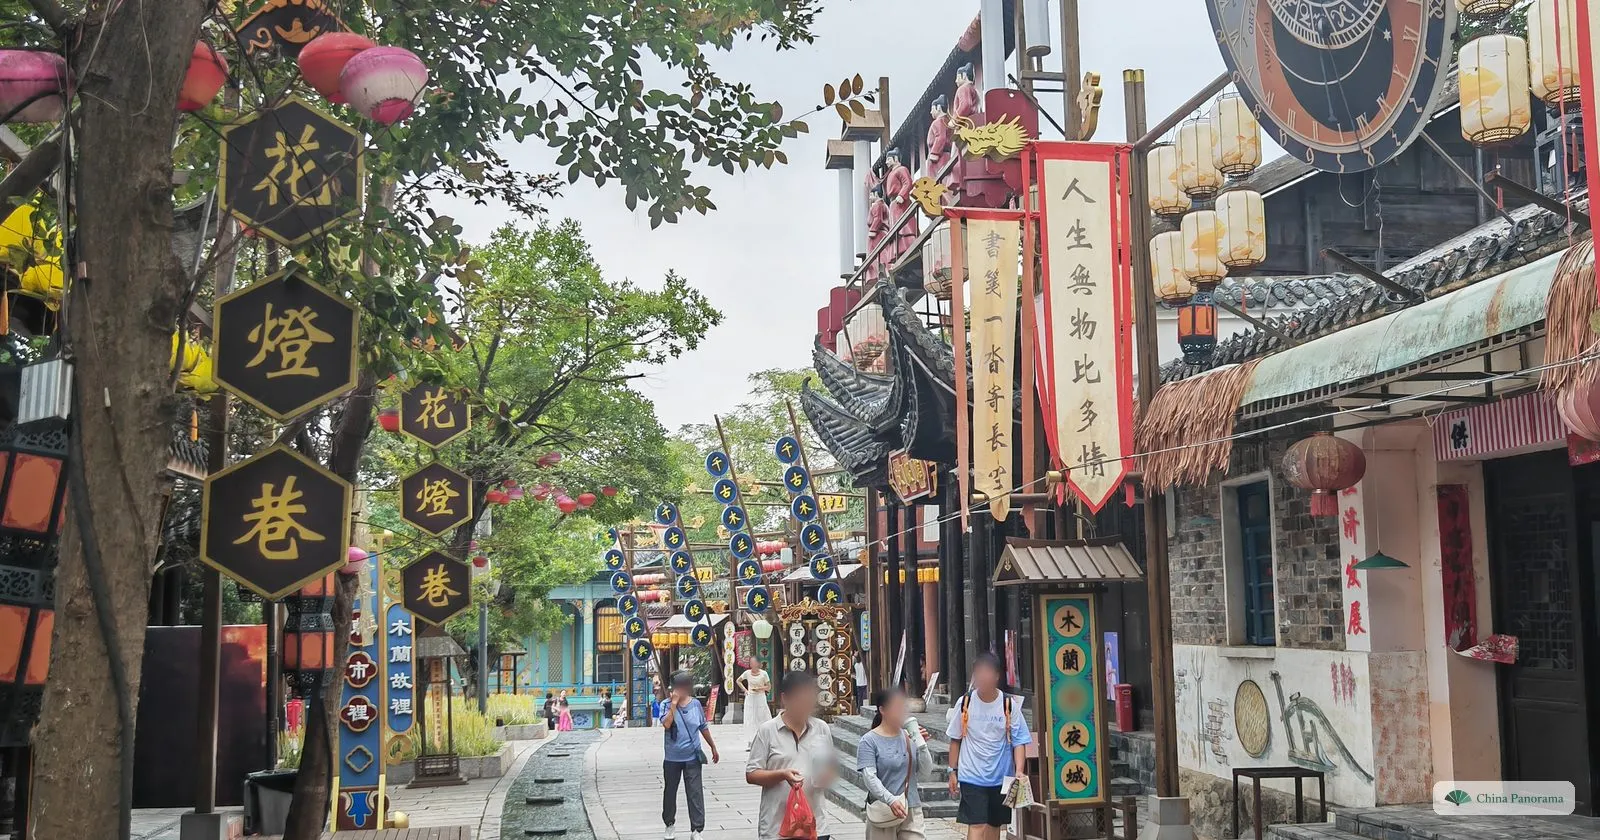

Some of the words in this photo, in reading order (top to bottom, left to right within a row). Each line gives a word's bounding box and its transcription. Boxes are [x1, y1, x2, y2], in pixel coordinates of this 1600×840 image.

[1062, 177, 1107, 480] 人生無物比多情
[415, 390, 461, 607] 花燈巷
[712, 457, 765, 609] 千古木兰经典
[389, 619, 413, 715] 木蘭故裡
[1060, 610, 1088, 786] 木蘭夜城
